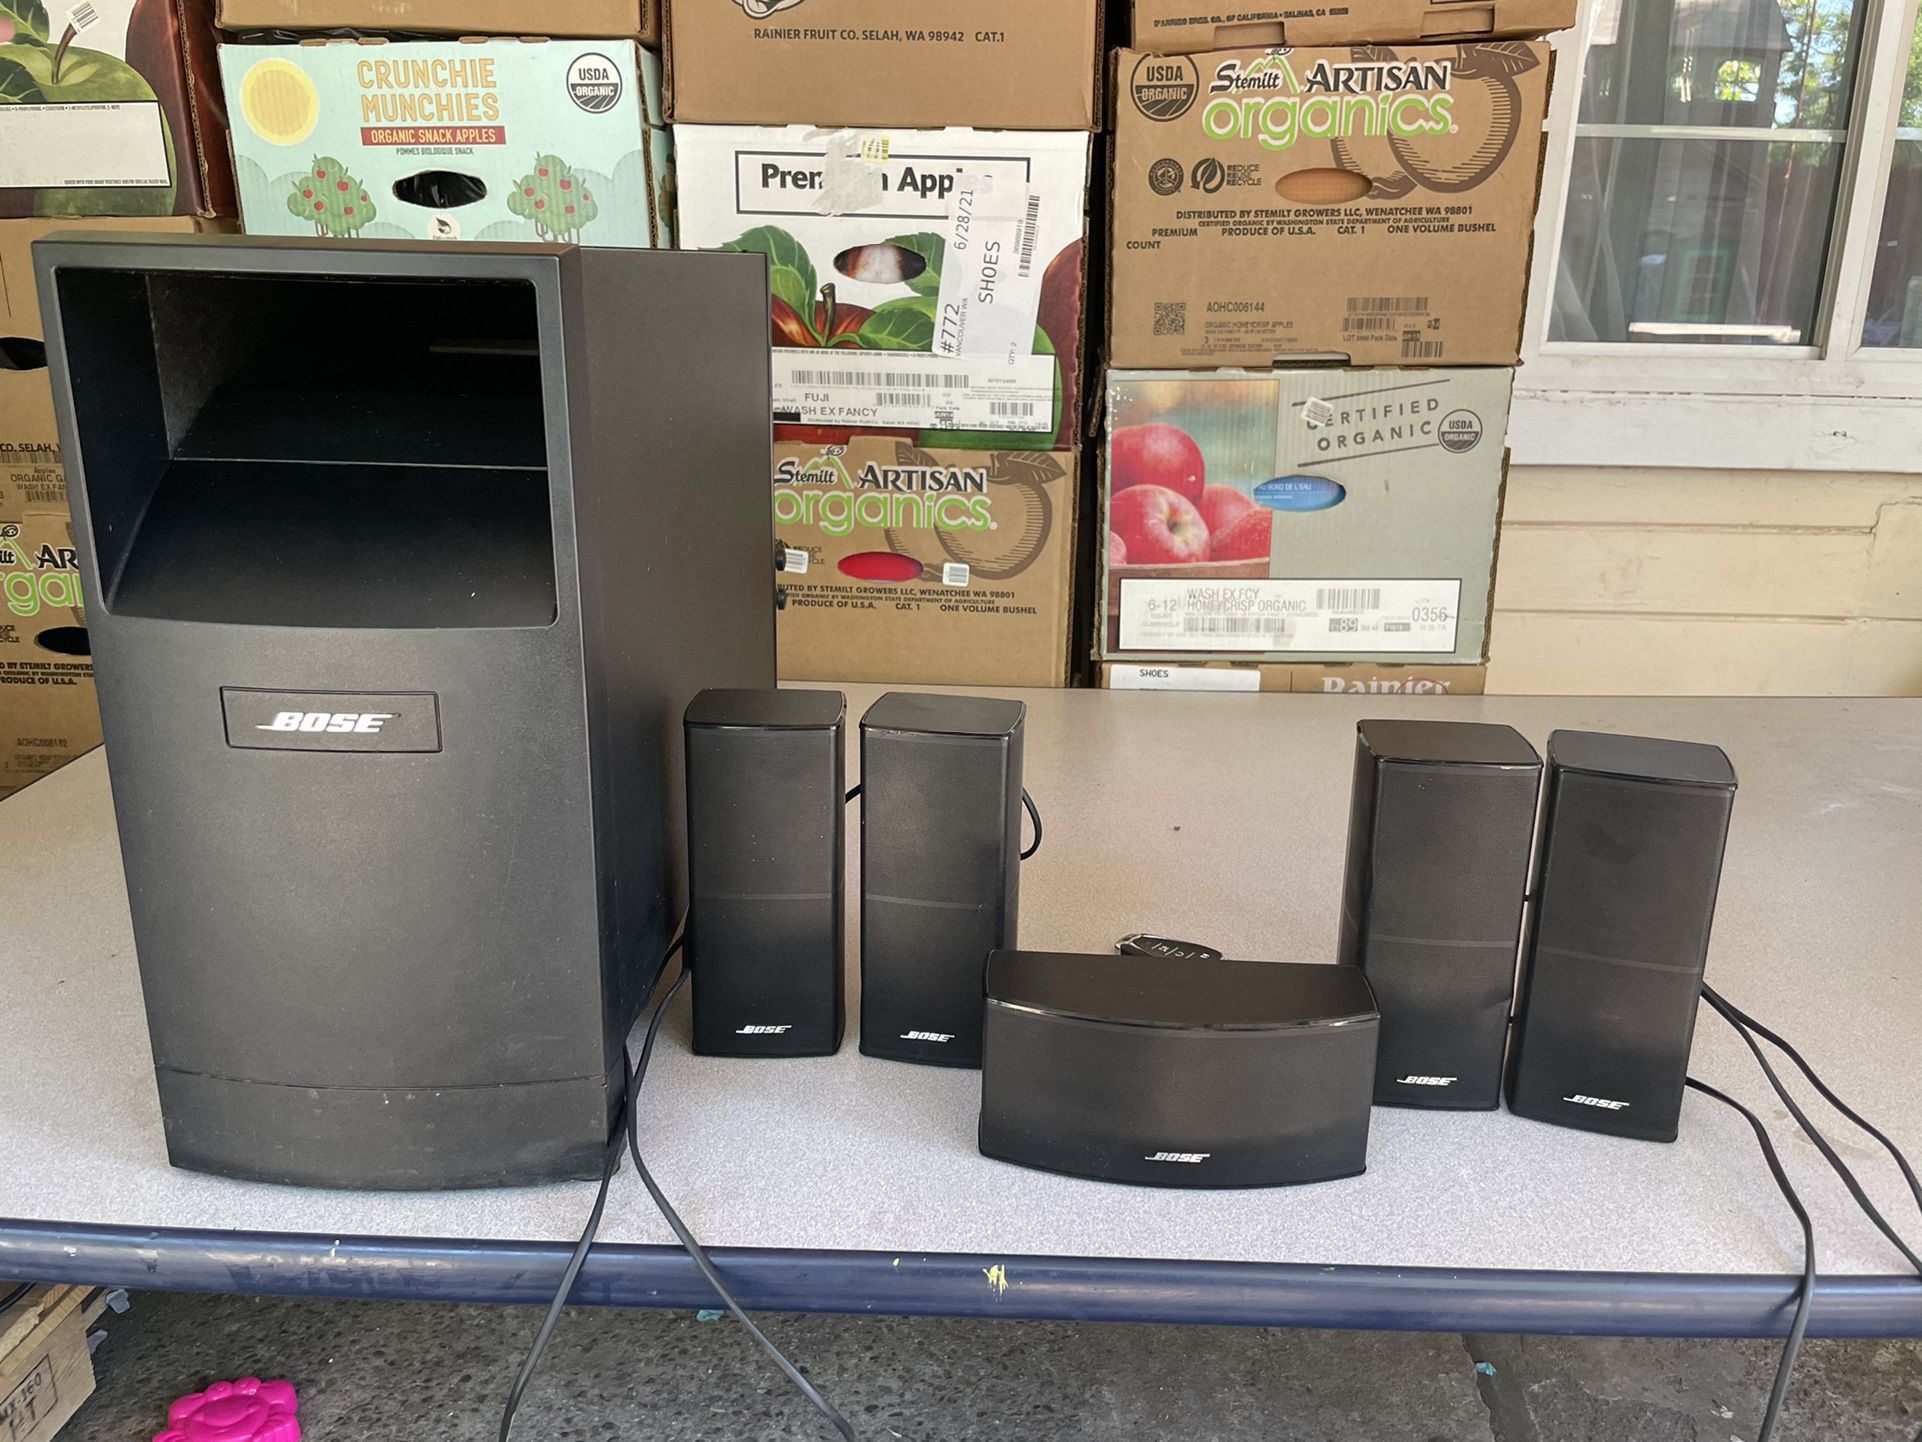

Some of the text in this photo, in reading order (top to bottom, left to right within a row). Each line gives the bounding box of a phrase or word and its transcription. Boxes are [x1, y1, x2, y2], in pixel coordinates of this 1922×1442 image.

[754, 28, 801, 40] RAINIER
[803, 29, 837, 40] FRUIT
[840, 30, 859, 41] CO.
[862, 30, 902, 42] SELAH,
[905, 30, 926, 41] WA
[928, 31, 964, 42] 98942
[357, 58, 497, 89] CRUNCHIE
[578, 68, 610, 81] USDA
[1147, 66, 1184, 82] USDA
[1210, 62, 1449, 94] Stemilt ARTISAN
[576, 86, 615, 97] ORGANIC
[1141, 87, 1188, 100] ORGANIC
[361, 92, 500, 122] MUNCHIES
[1203, 94, 1455, 151] organics
[371, 129, 496, 144] ORGANIC SNACK APPLES
[396, 147, 420, 156] POMMES
[455, 147, 474, 155] SNACK
[1227, 164, 1260, 173] REDUCE
[1226, 178, 1262, 186] RECYCLE
[954, 189, 974, 250] 6/28/21
[1176, 206, 1472, 220] DISTRIBUTED BY STEMILT GROWERS LLC, WENATCHEE WA 98801
[1152, 223, 1496, 237] PREMIUM PRODUCE OF U.S.A. CAT. 1 ONE VOLUME BUSHEL
[1126, 241, 1161, 250] COUNT
[978, 241, 1001, 304] SHOES
[940, 303, 960, 355] #772
[954, 297, 968, 357] VANCOUVER WA
[1008, 348, 1016, 365] QTY:
[804, 393, 829, 402] FUJI
[783, 405, 878, 417] WASH EX FANCY
[1448, 420, 1473, 430] USDA
[1317, 421, 1432, 451] ORGANIC
[1444, 432, 1476, 441] ORGANIC
[19, 443, 55, 454] SELAH,
[10, 473, 53, 483] ORGANIC
[774, 461, 984, 492] Stemilt ARTISAN
[16, 483, 39, 491] WASH
[774, 491, 992, 537] organics
[807, 584, 818, 592] BY
[820, 585, 854, 594] STEMILT
[856, 586, 898, 595] GROWERS
[900, 588, 917, 597] LLC,
[920, 589, 970, 598] WENATCHEE
[973, 590, 988, 598] WA
[989, 591, 1015, 599] 98801
[1187, 588, 1260, 599] WASH EX FCY
[791, 599, 1037, 614] PRODUCE OF U.S.A. CAT. 1 ONE VOLUME BUSHEL
[1147, 599, 1177, 612] 6-12
[1186, 600, 1306, 612] HONEYCRISP ORGANIC
[1412, 607, 1449, 622] 0356
[19, 662, 51, 670] STEMILT
[1139, 668, 1169, 678] SHOES
[38, 677, 50, 685] OF
[52, 677, 77, 685] U.S.A.
[256, 711, 400, 733] BOSE
[735, 1025, 792, 1035] BOSE
[900, 1030, 955, 1042] BOSE
[1396, 1076, 1457, 1087] BOSE
[1562, 1094, 1630, 1110] BOSE
[1144, 1152, 1211, 1164] BOSE
